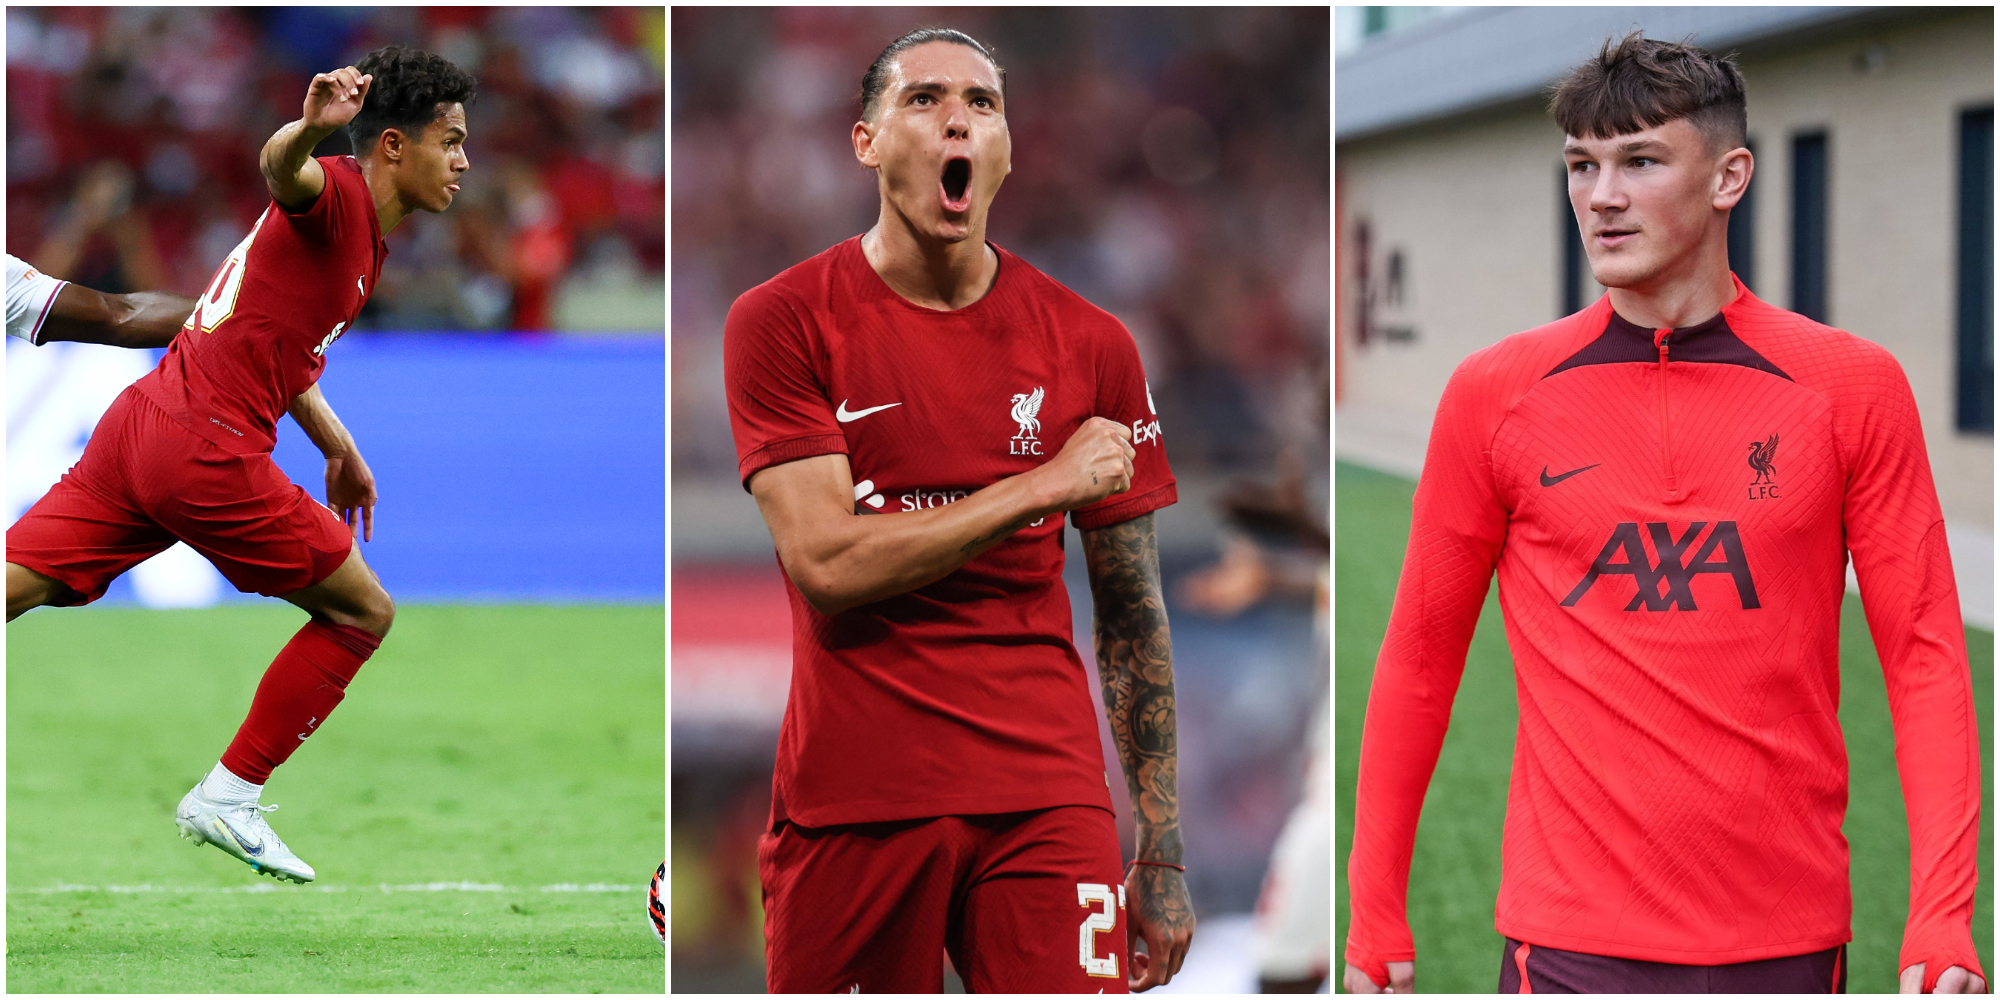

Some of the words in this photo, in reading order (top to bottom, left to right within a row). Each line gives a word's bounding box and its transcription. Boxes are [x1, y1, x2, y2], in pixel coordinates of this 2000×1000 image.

[1009, 440, 1044, 456] L.F.C.
[1748, 485, 1782, 500] L.F.C.
[1559, 520, 1762, 611] AXA
